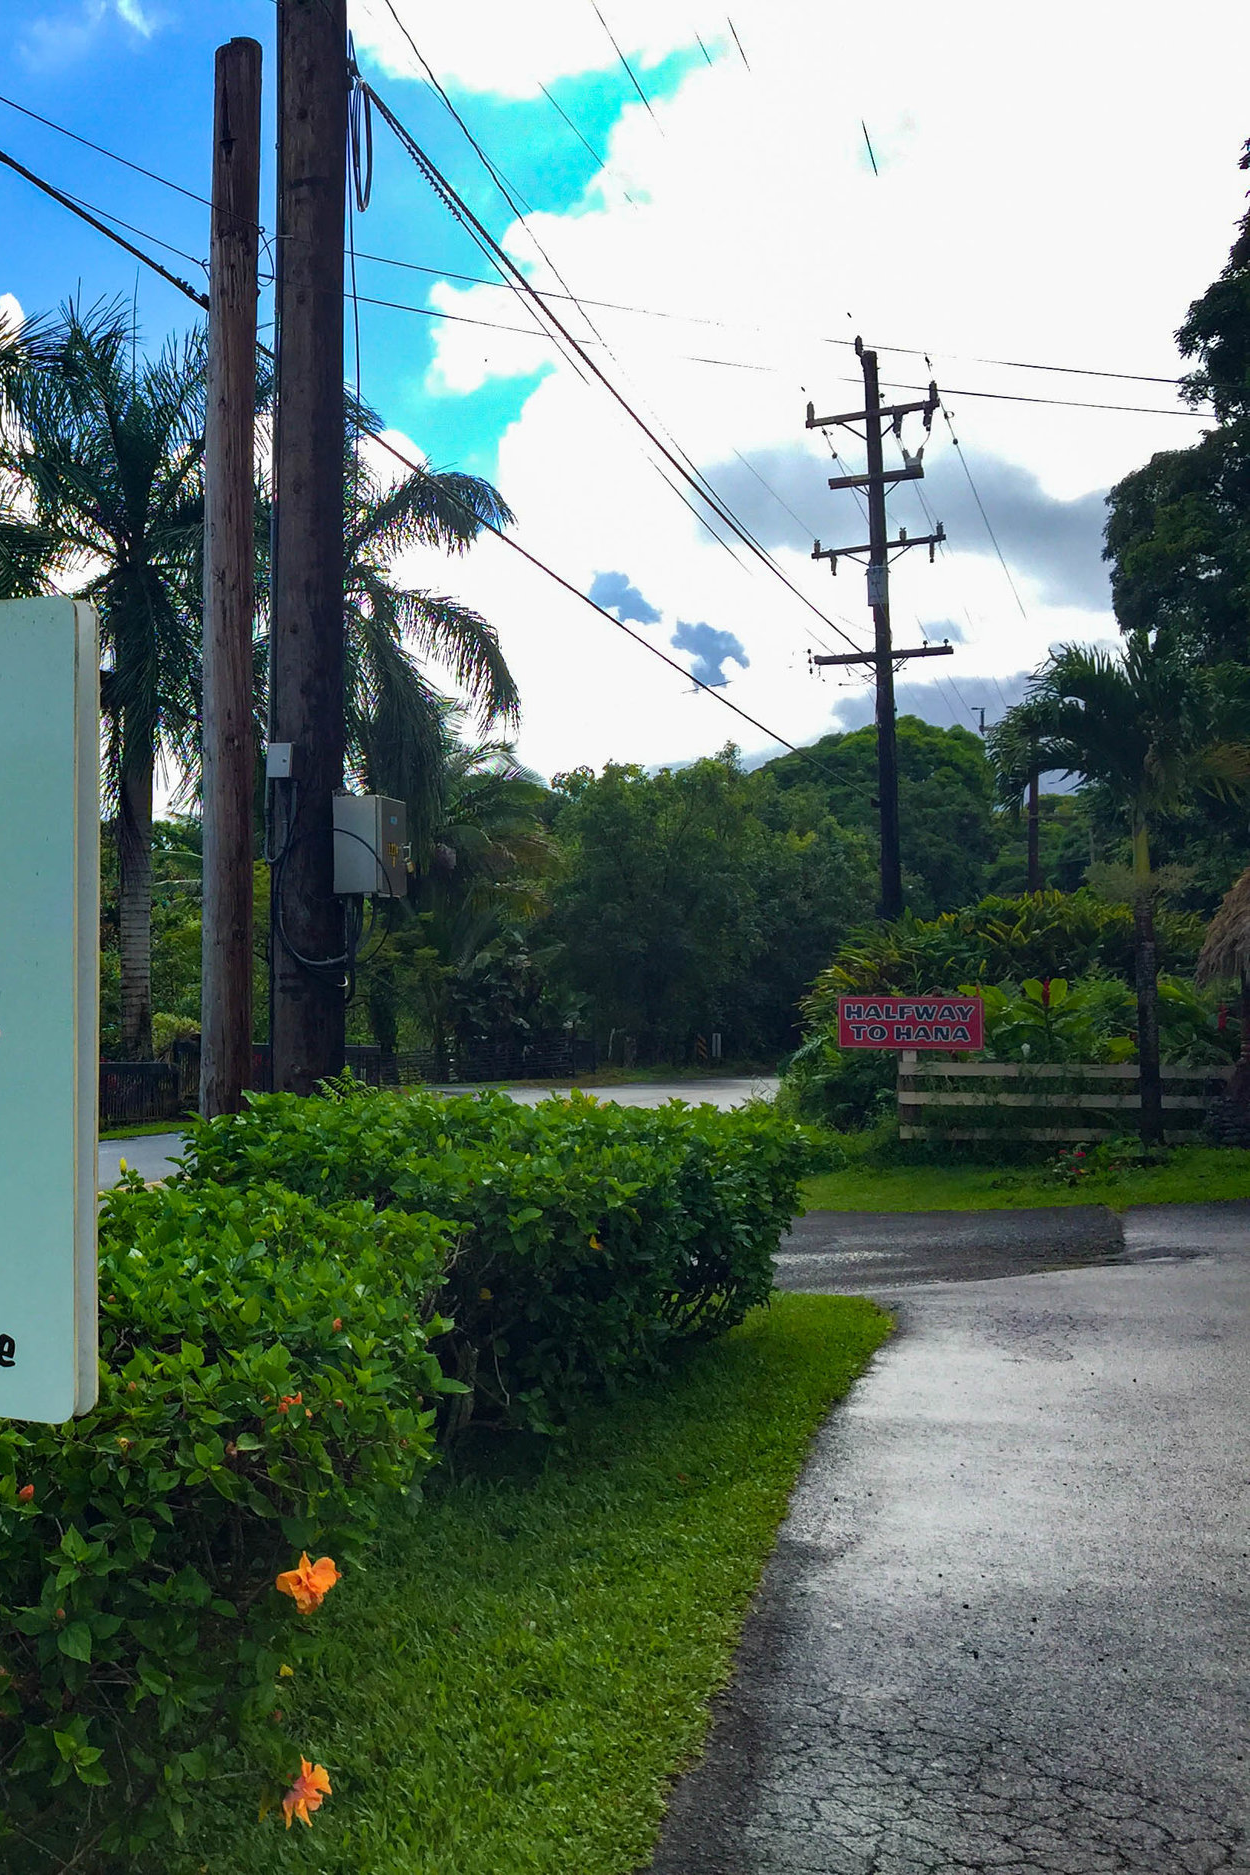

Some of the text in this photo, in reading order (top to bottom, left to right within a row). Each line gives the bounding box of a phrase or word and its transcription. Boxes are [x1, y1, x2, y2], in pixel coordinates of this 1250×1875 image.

[844, 1004, 975, 1021] HALFWAY
[850, 1024, 971, 1042] TO HANA
